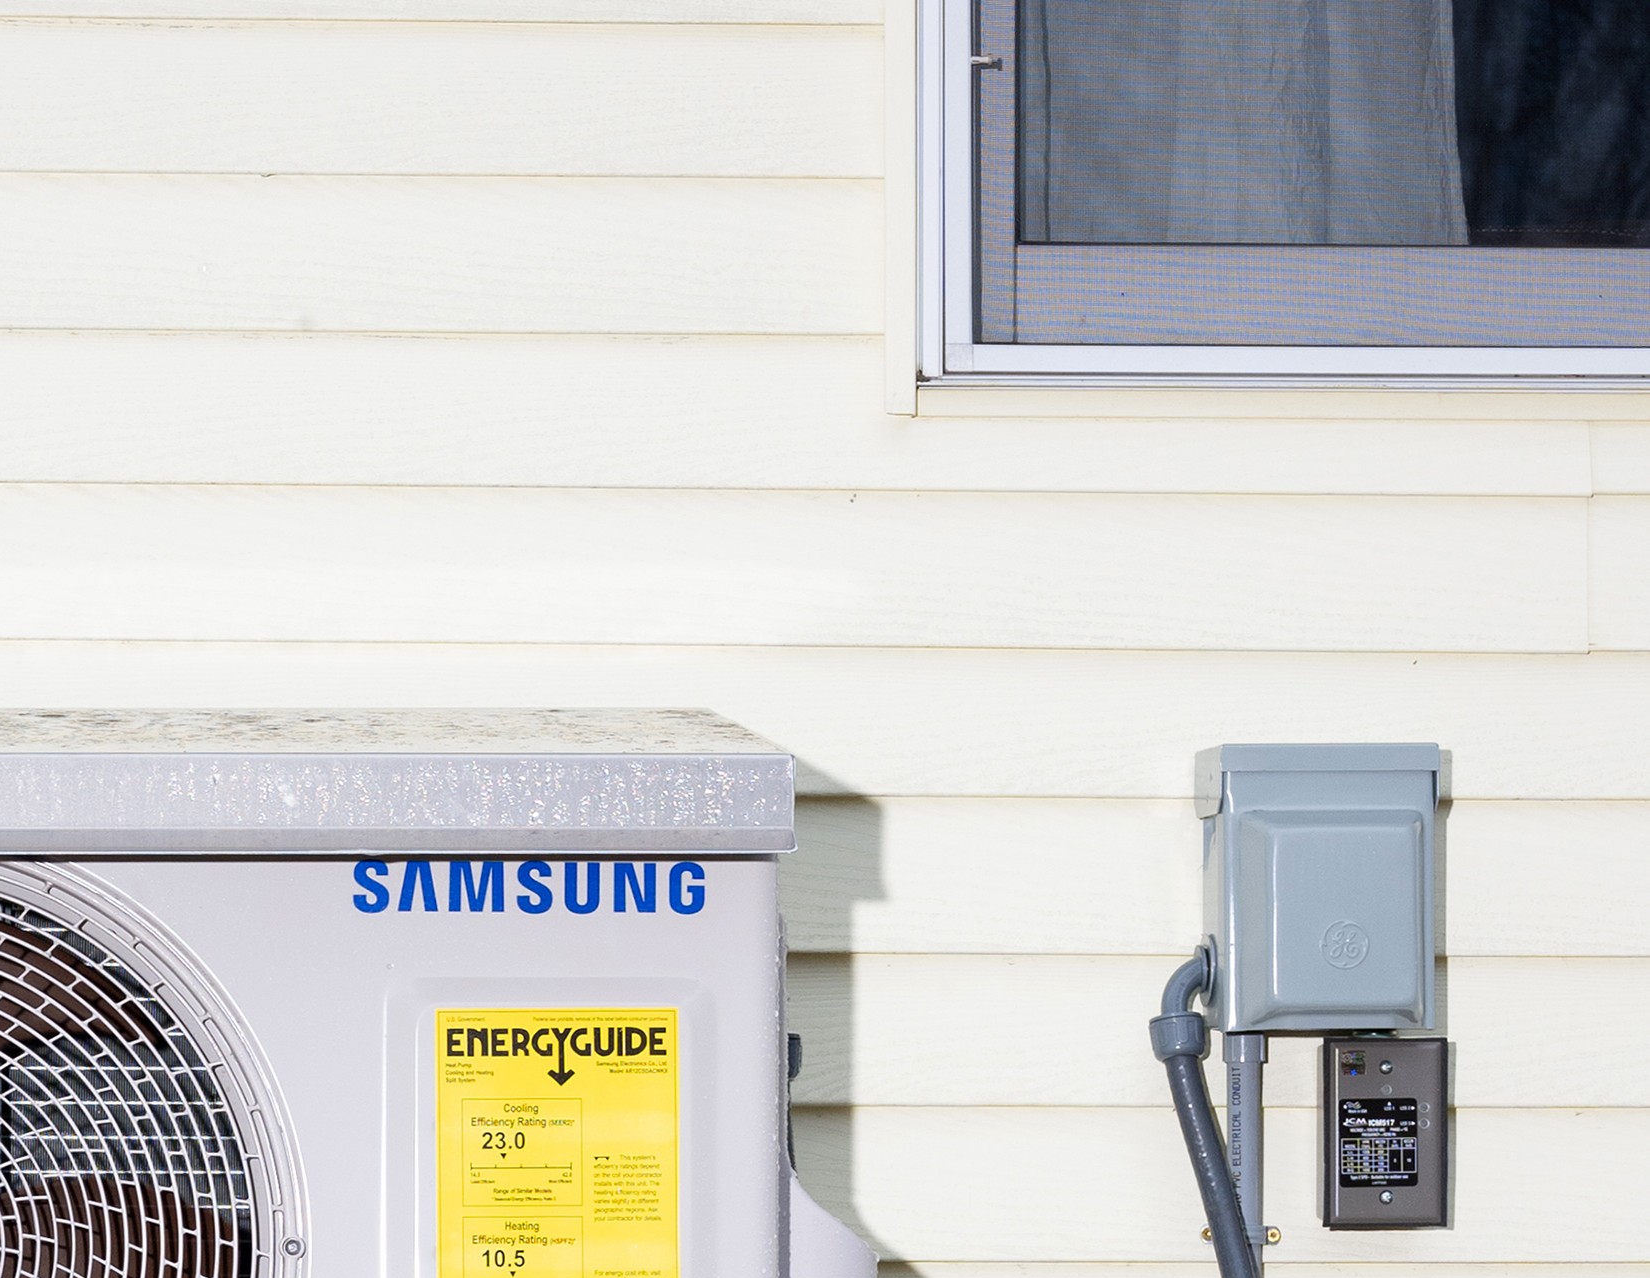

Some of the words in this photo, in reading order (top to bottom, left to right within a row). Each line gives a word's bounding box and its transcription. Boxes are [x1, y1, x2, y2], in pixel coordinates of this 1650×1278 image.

[353, 859, 705, 915] SAMSUNG
[446, 1027, 667, 1060] ENERGYGUIDE
[1232, 1067, 1241, 1105] CONDUIT
[503, 1103, 539, 1115] Cooling
[471, 1117, 515, 1128] Efficiency
[517, 1117, 547, 1128] Rating
[481, 1132, 525, 1149] 23.0
[1232, 1111, 1241, 1166] ELECTRICAL
[505, 1221, 540, 1232] Heating
[472, 1235, 516, 1246] Efficiency
[518, 1235, 548, 1246] Rating
[482, 1250, 525, 1267] 10.5
